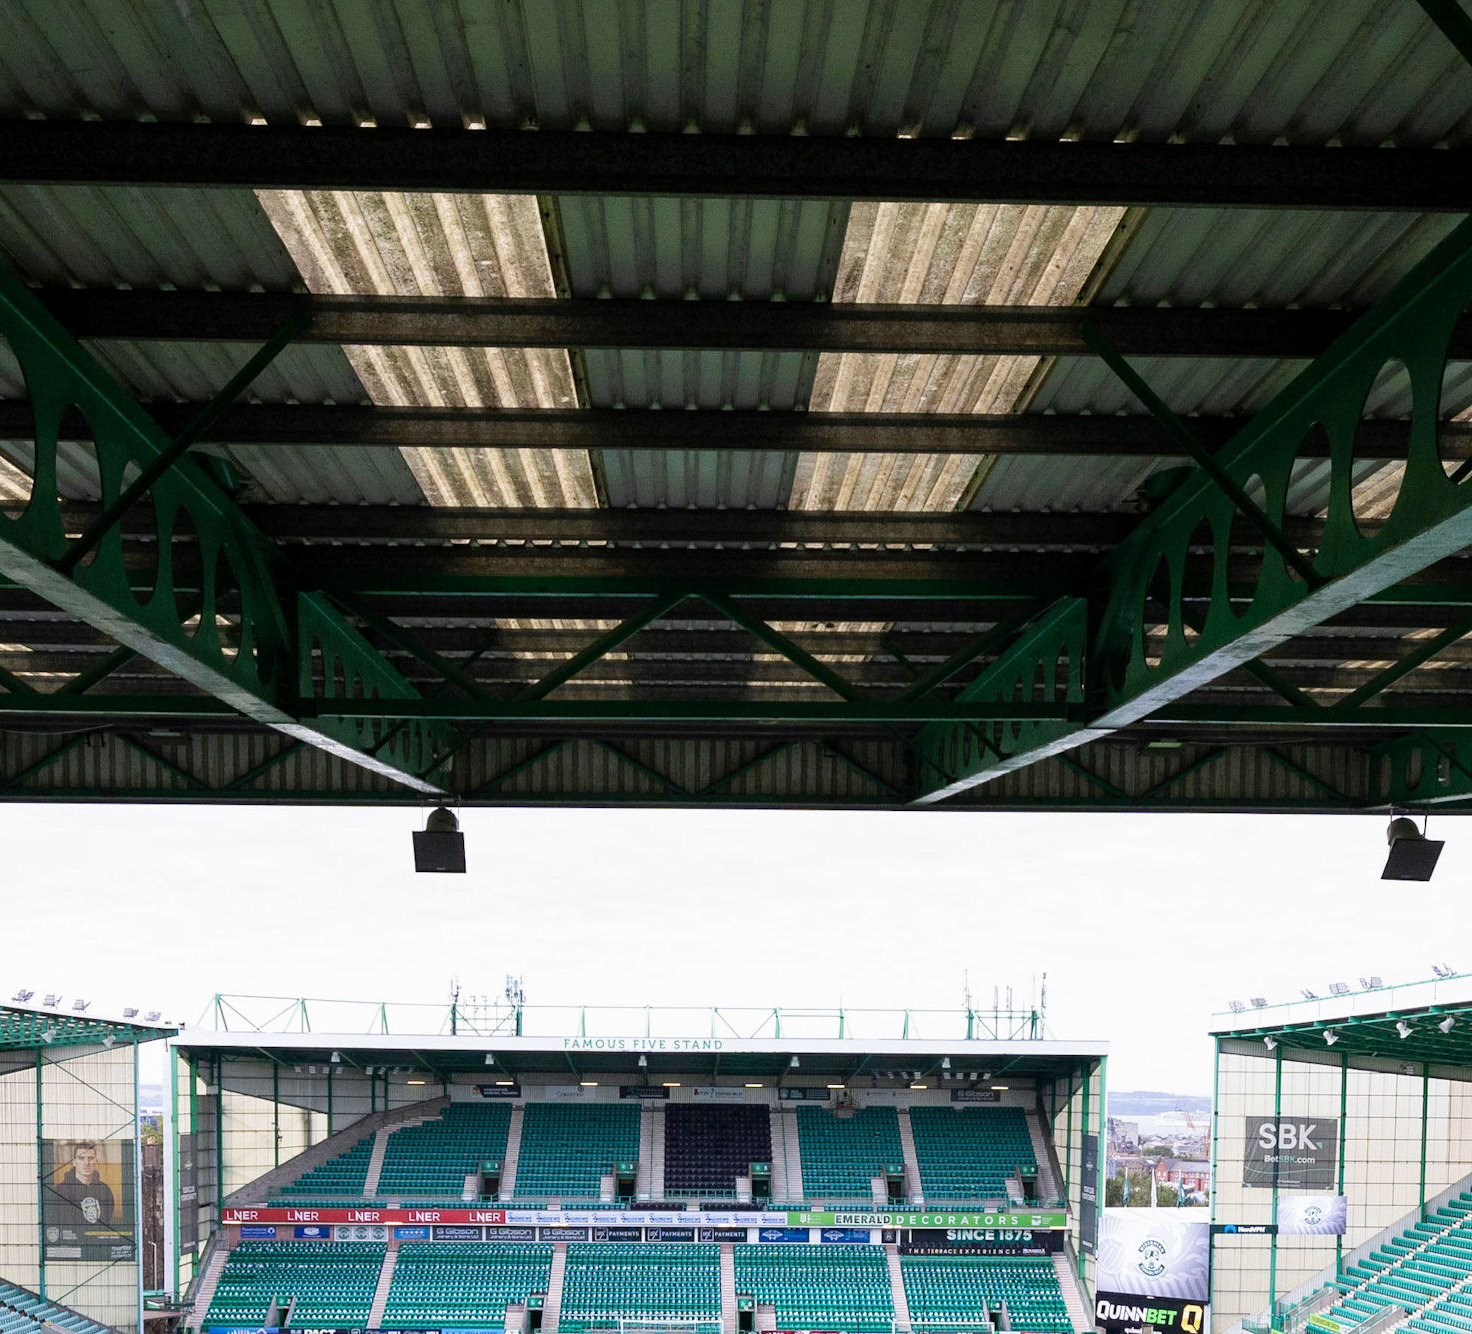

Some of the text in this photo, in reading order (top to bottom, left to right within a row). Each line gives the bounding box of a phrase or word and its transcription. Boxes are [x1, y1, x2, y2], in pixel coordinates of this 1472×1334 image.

[564, 1039, 723, 1050] FAMOUS FIVE STAND
[1259, 1123, 1317, 1150] SBK
[1264, 1155, 1316, 1164] BetSBK.com
[287, 1210, 319, 1222] LNER
[348, 1210, 380, 1222] LNER
[408, 1211, 440, 1223] LNER
[469, 1211, 501, 1223] LNER
[834, 1214, 1019, 1225] EMERALD DECORATORS
[946, 1230, 1033, 1241] SINCE 1875
[1097, 1300, 1203, 1334] QUINNBET Q
